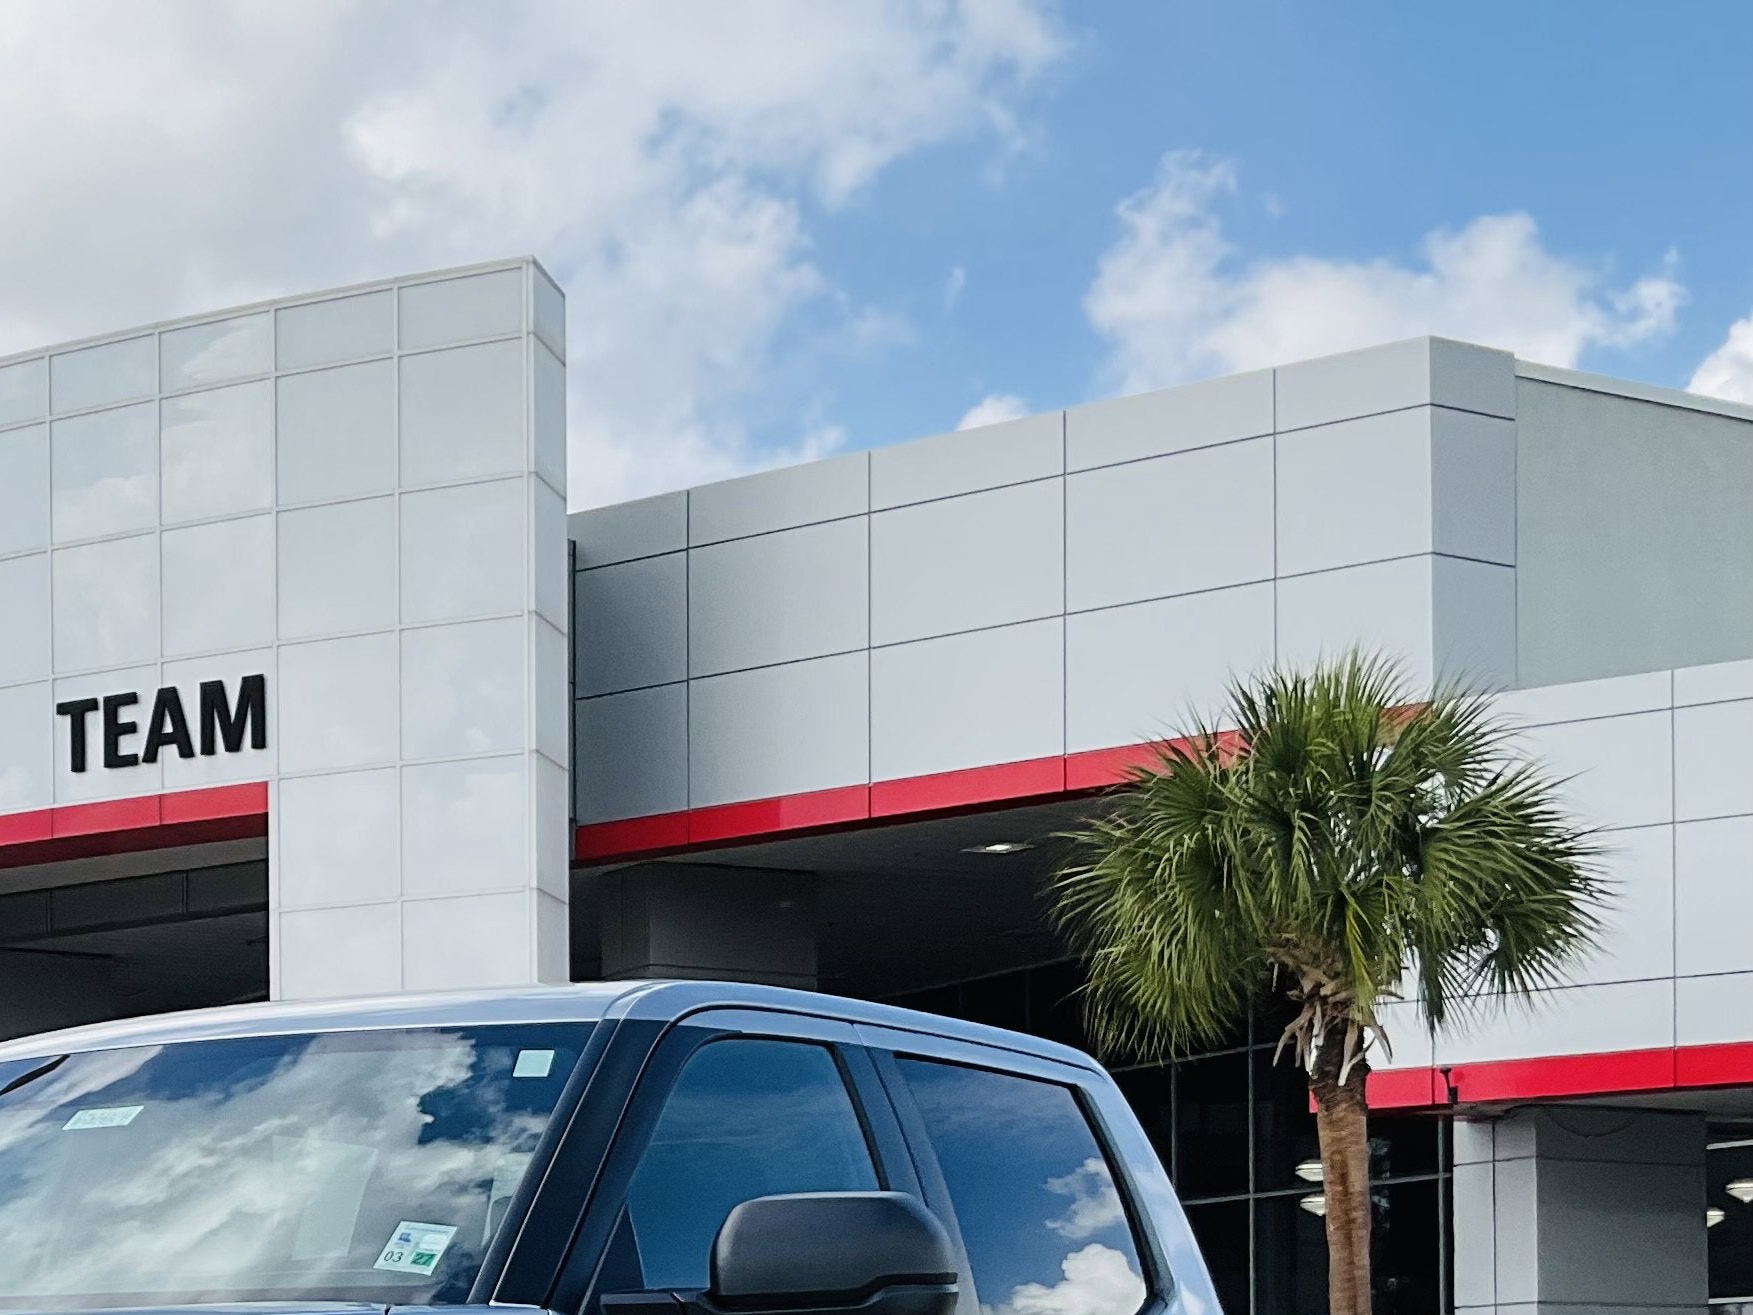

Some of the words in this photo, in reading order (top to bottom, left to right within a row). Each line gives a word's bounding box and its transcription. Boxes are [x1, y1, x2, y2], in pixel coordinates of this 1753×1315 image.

[56, 673, 267, 773] TEAM
[383, 1250, 404, 1263] 03
[414, 1253, 435, 1265] 27
